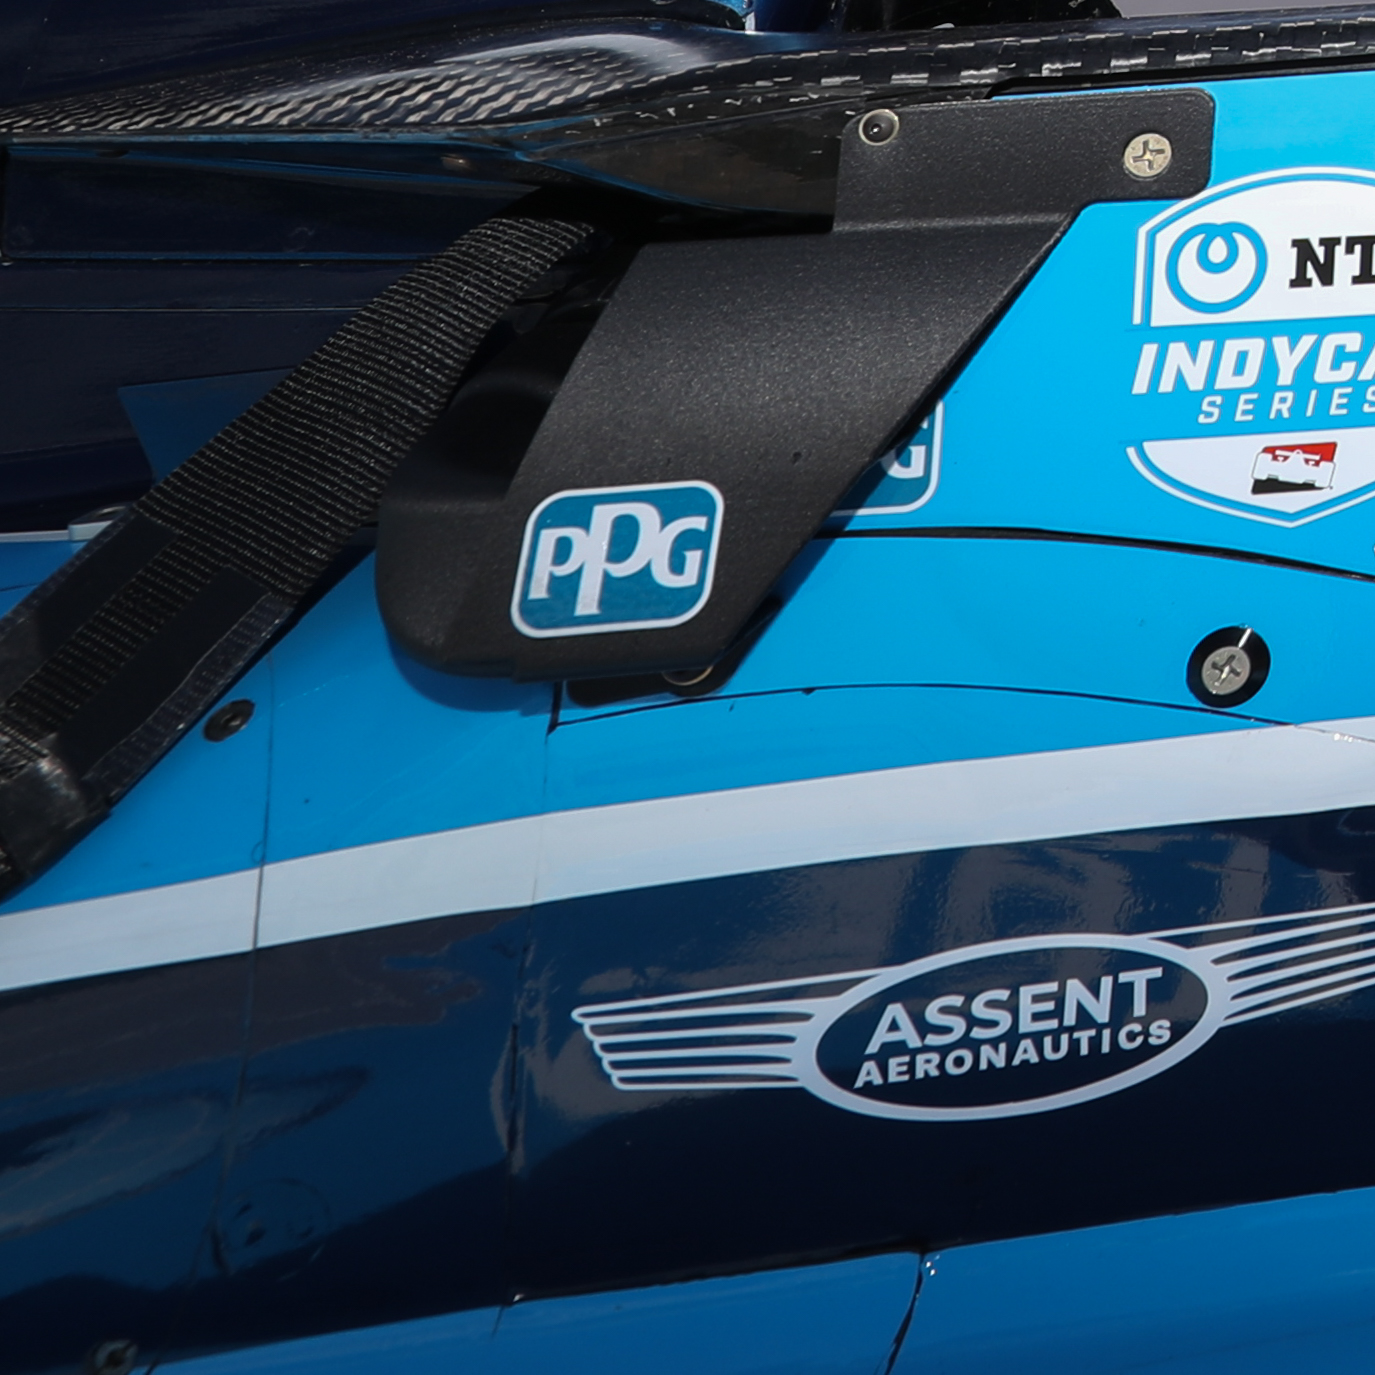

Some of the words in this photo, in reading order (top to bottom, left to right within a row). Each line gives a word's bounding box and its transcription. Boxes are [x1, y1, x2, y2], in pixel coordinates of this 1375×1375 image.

[528, 502, 708, 617] PPG
[853, 1019, 1172, 1090] AERONAUTICS
[864, 967, 1163, 1055] ASSENT
